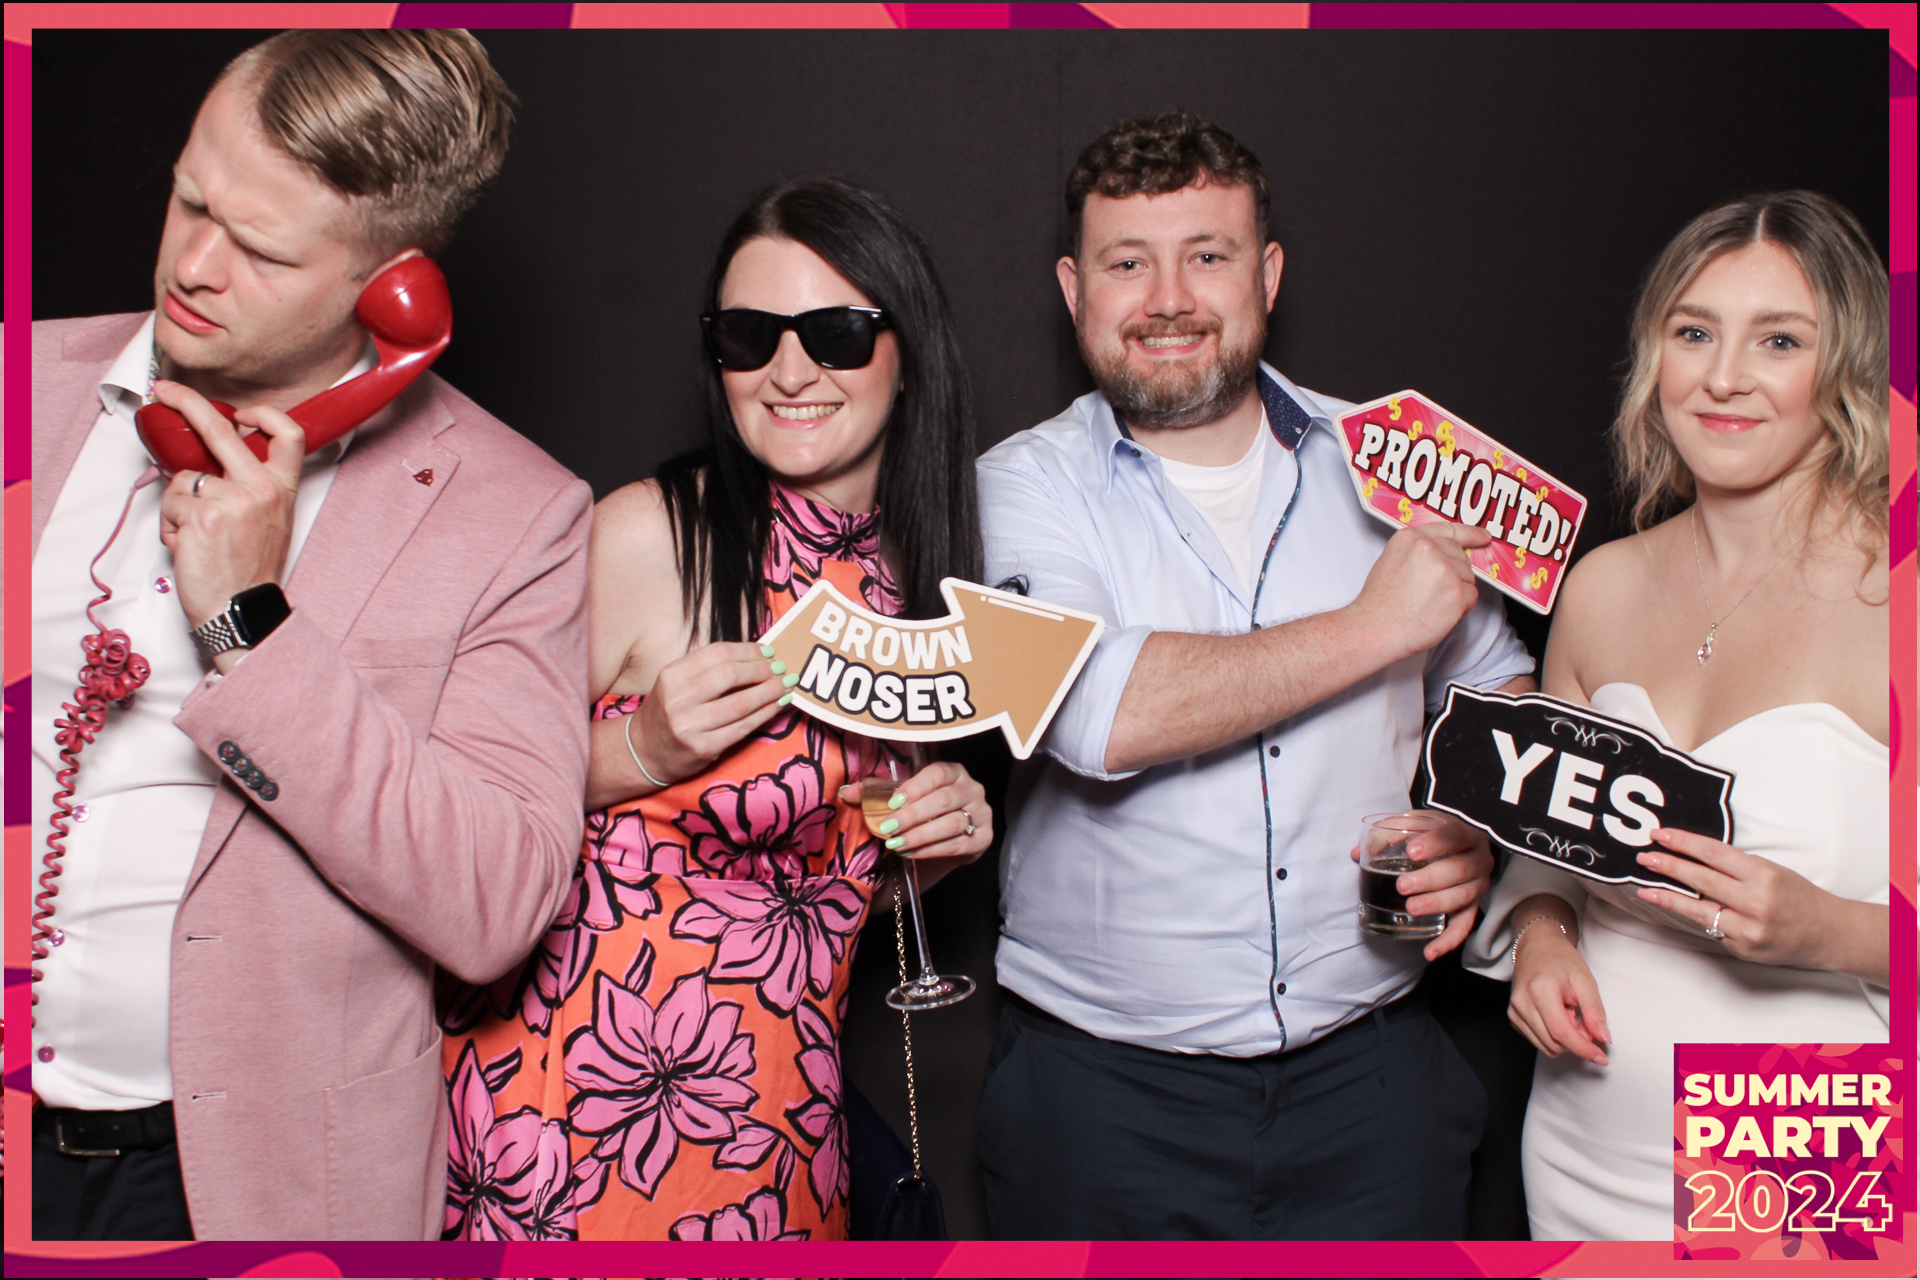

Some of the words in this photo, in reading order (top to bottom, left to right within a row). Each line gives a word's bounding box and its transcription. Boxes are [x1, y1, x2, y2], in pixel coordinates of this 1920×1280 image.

[1354, 423, 1572, 561] PROMOTED!
[810, 600, 973, 670] BROWN
[799, 646, 973, 722] NOSER
[1491, 728, 1665, 847] YES
